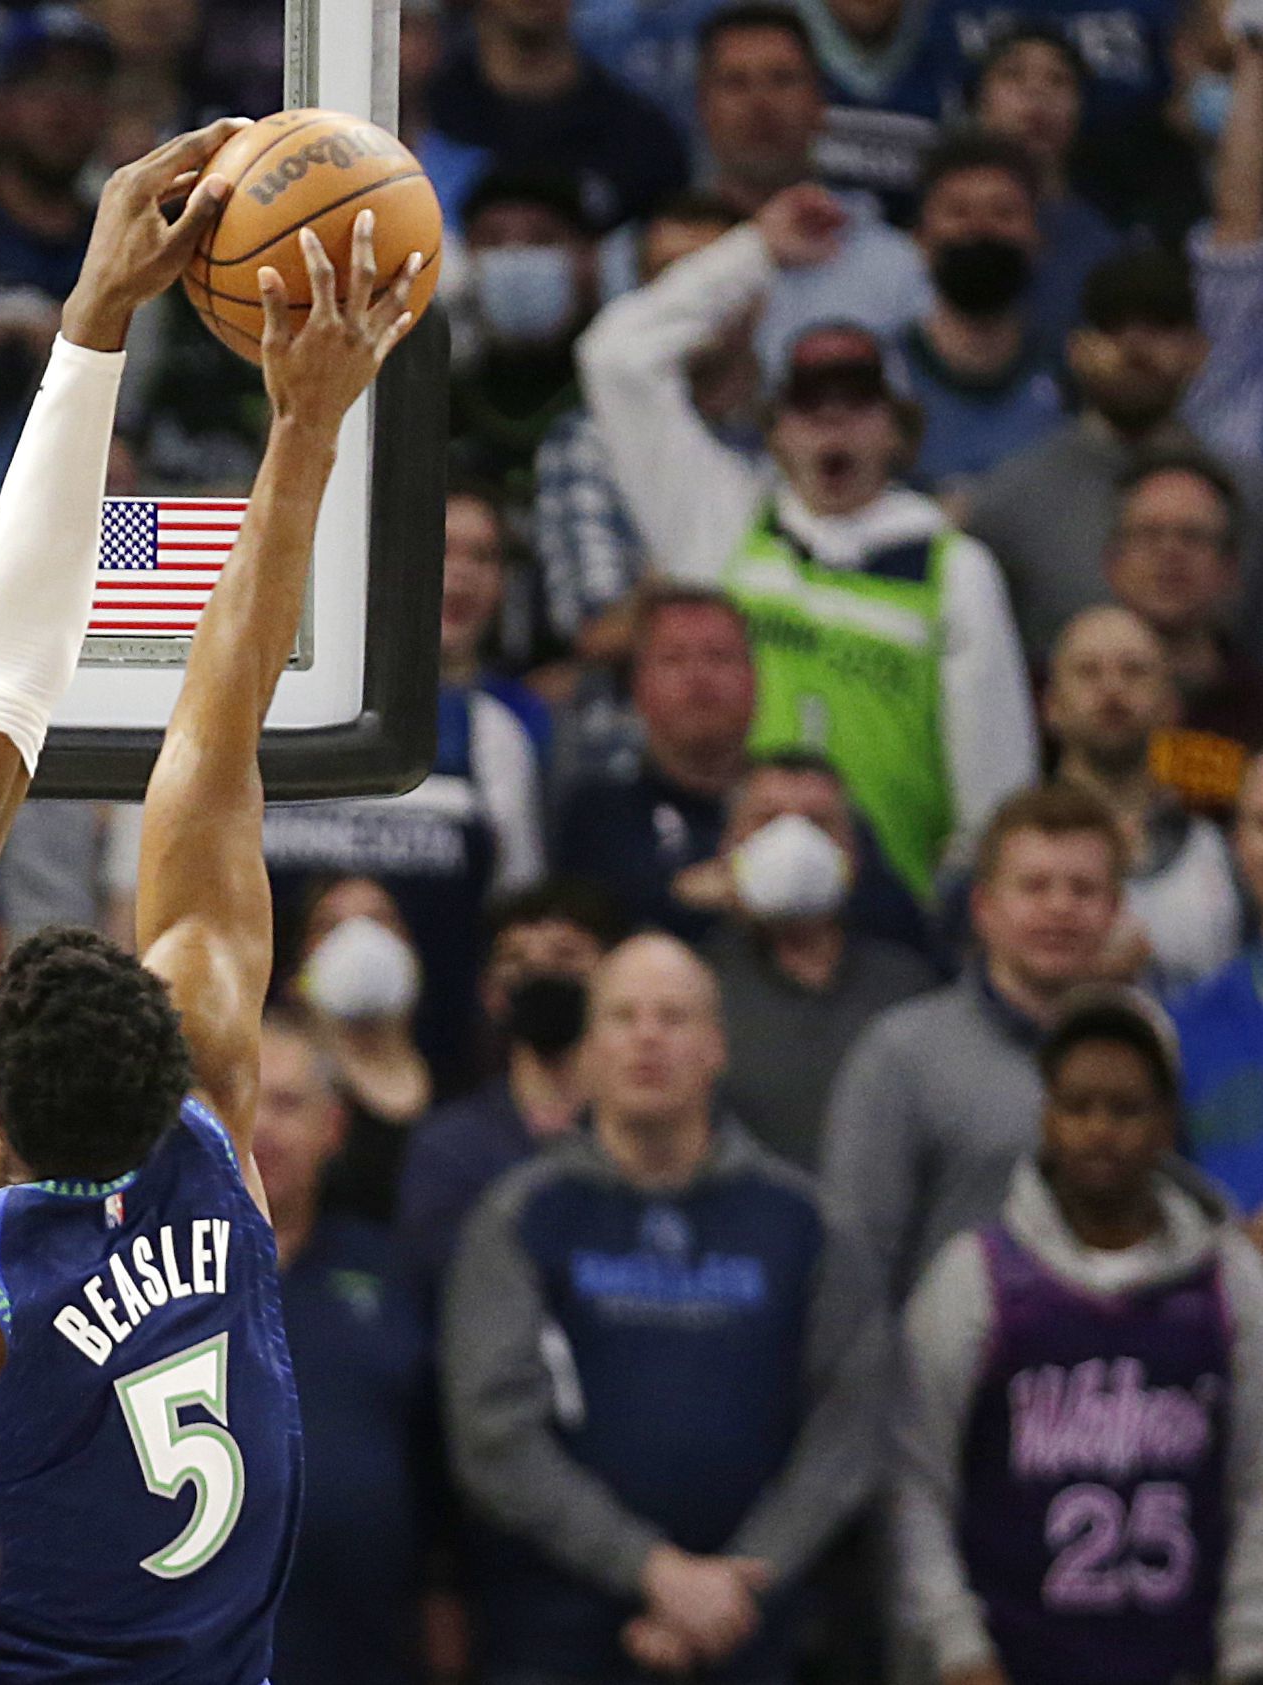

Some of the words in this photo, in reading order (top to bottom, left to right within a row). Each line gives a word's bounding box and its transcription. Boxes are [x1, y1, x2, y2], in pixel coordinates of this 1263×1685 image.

[53, 1218, 230, 1367] BEASLEY
[113, 1331, 245, 1580] 5
[1043, 1482, 1197, 1609] 25
